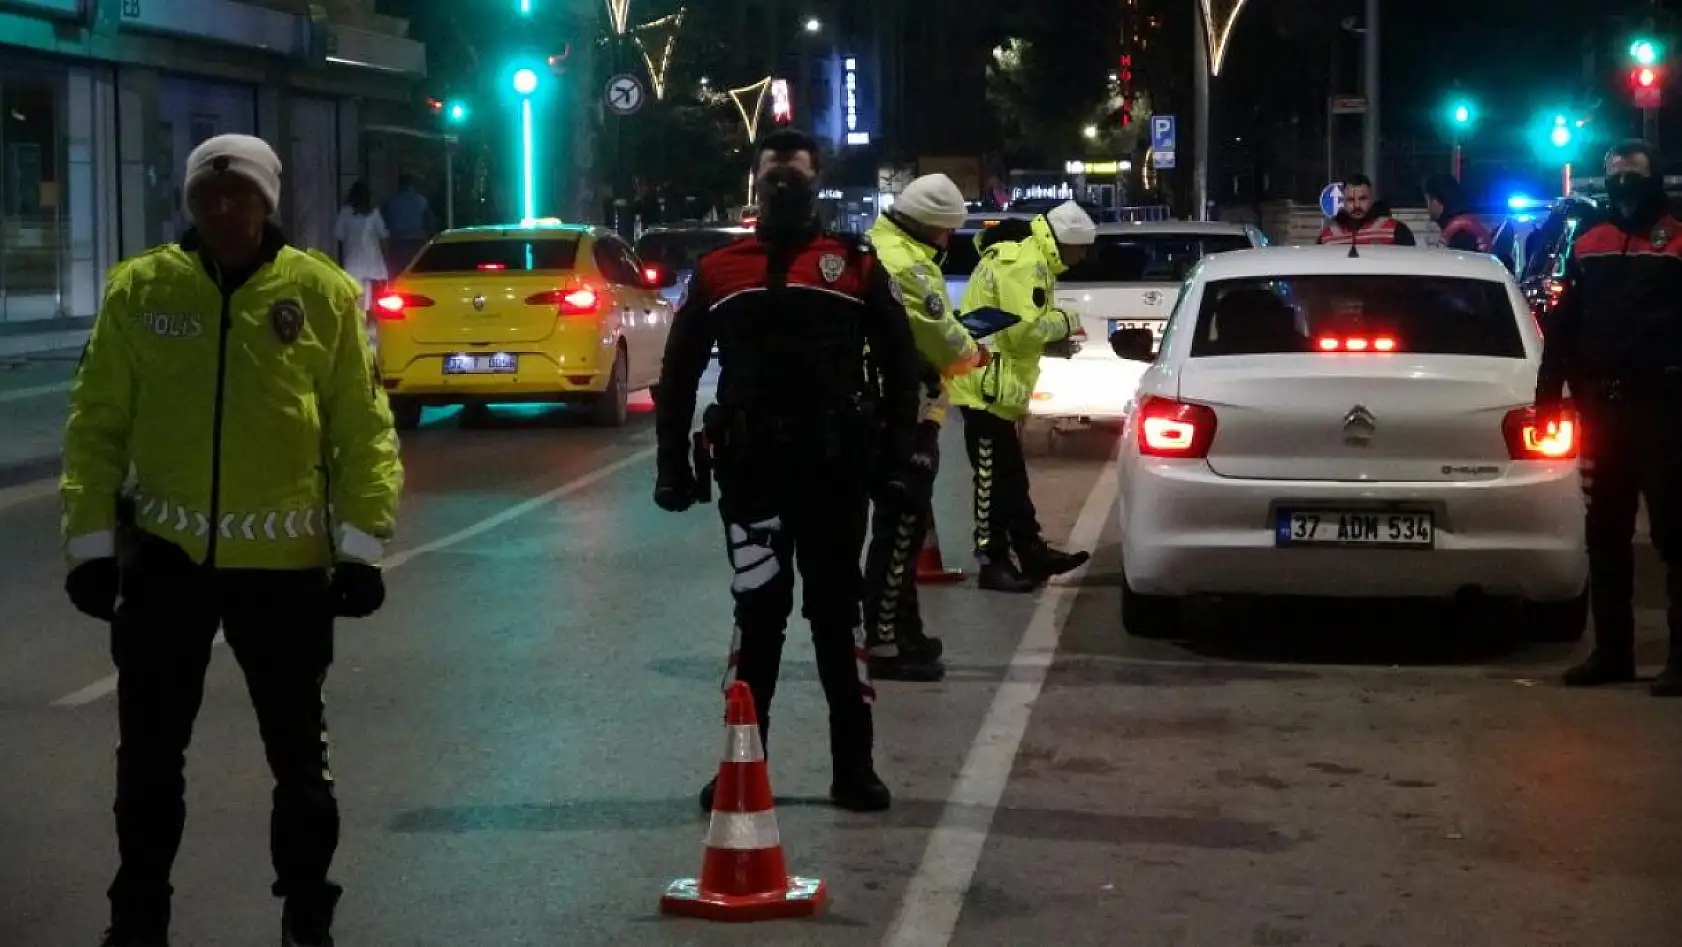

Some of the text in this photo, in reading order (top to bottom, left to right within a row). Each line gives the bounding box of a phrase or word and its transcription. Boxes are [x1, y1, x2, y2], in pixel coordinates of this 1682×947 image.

[1155, 119, 1171, 139] P
[1293, 514, 1320, 538] 37
[1338, 515, 1379, 540] ADM
[1389, 516, 1429, 541] 534
